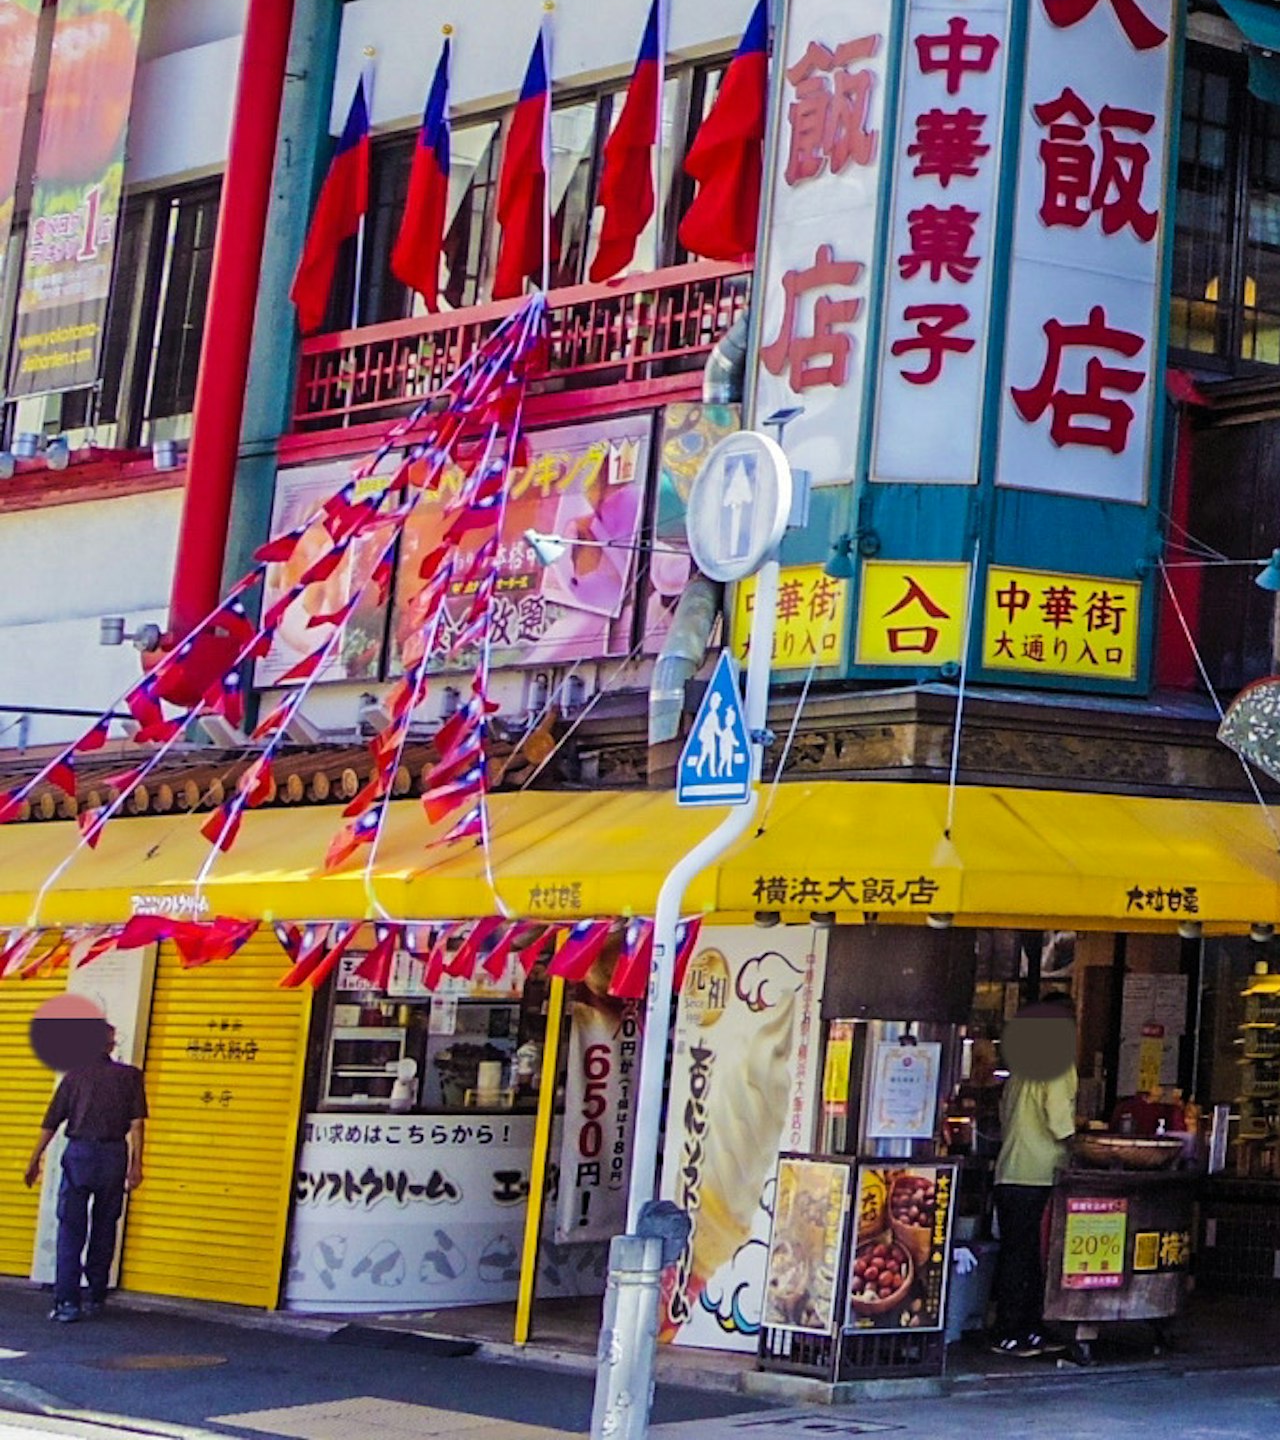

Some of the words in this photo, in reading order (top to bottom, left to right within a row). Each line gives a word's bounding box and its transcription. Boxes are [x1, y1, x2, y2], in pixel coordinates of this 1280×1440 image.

[881, 575, 951, 655] 入口
[996, 580, 1128, 636] 中華街
[993, 631, 1124, 666] 大通り入口
[752, 874, 940, 907] 横浜大飯店
[1125, 886, 1200, 914] 大粒甘栗
[1070, 1233, 1120, 1257] 20%
